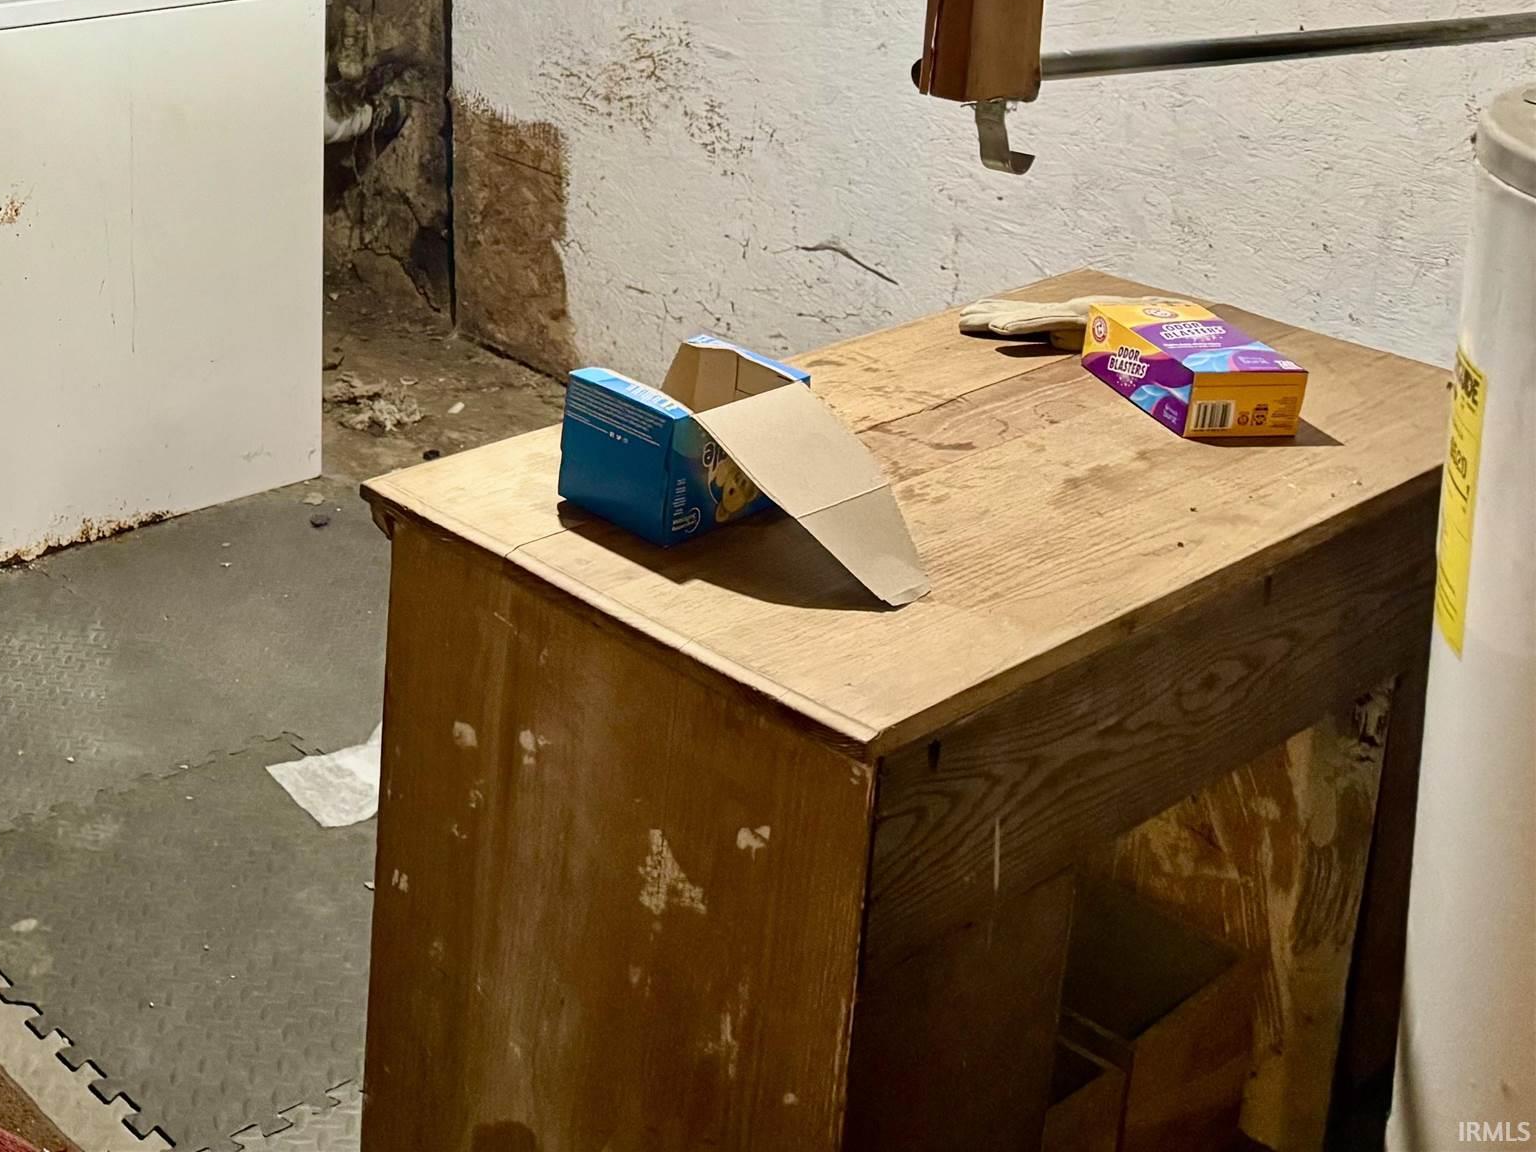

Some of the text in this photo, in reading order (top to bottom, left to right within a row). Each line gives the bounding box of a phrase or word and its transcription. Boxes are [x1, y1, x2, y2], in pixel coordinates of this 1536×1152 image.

[1163, 327, 1223, 339] BLASTERS
[1165, 322, 1200, 332] ODOR
[1118, 346, 1140, 361] ODOR
[1109, 357, 1146, 376] BLASTERS
